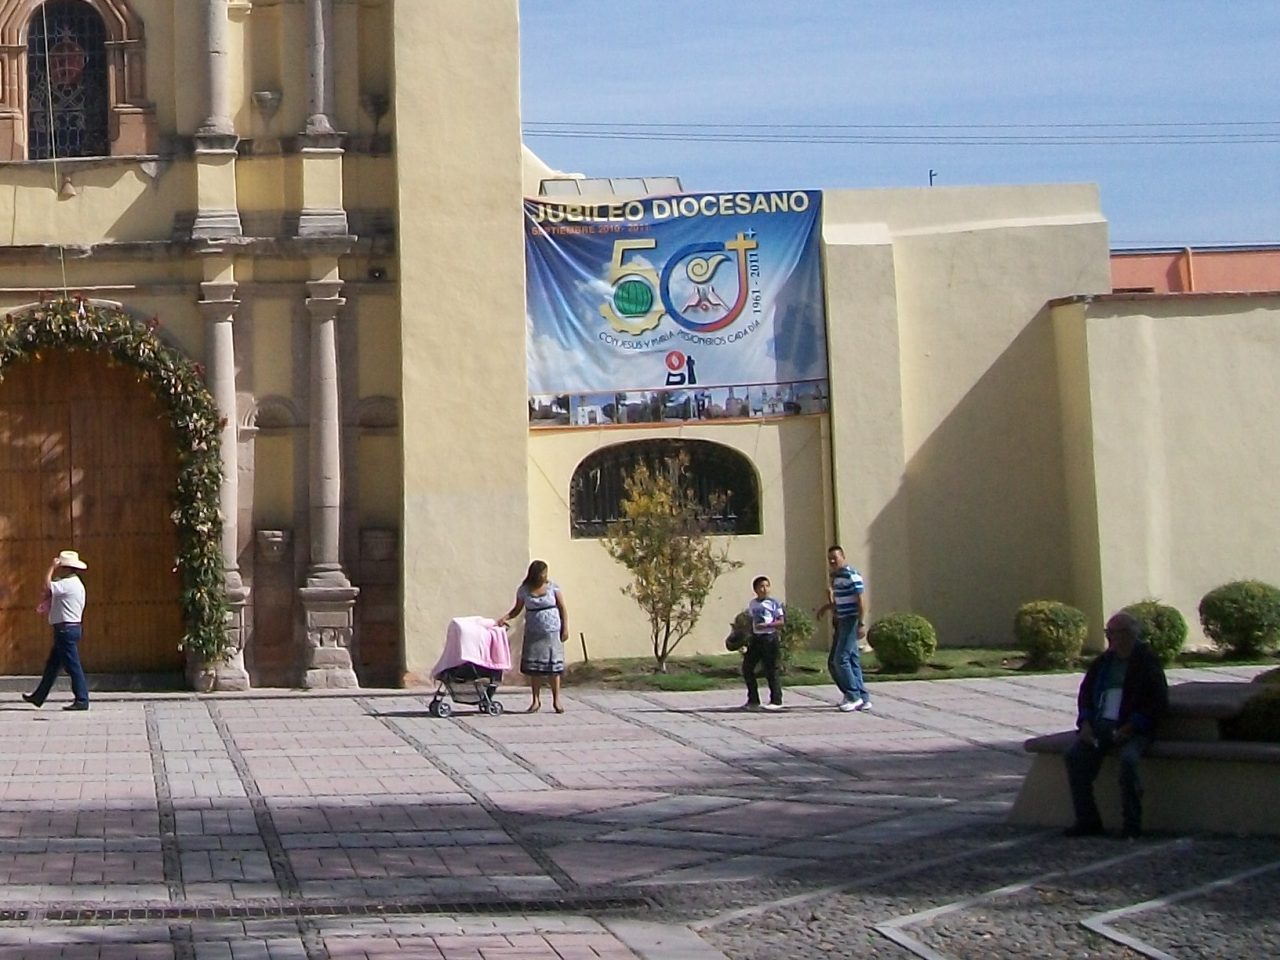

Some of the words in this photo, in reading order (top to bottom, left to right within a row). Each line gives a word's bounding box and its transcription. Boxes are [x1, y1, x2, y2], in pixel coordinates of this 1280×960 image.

[531, 201, 645, 223] JUBILEO
[652, 191, 809, 218] DIOCESANO
[531, 225, 595, 236] SEPTIEMBRE
[749, 253, 760, 277] 2011
[751, 290, 761, 313] 1961
[599, 332, 618, 346] CON
[727, 329, 748, 343] CADA
